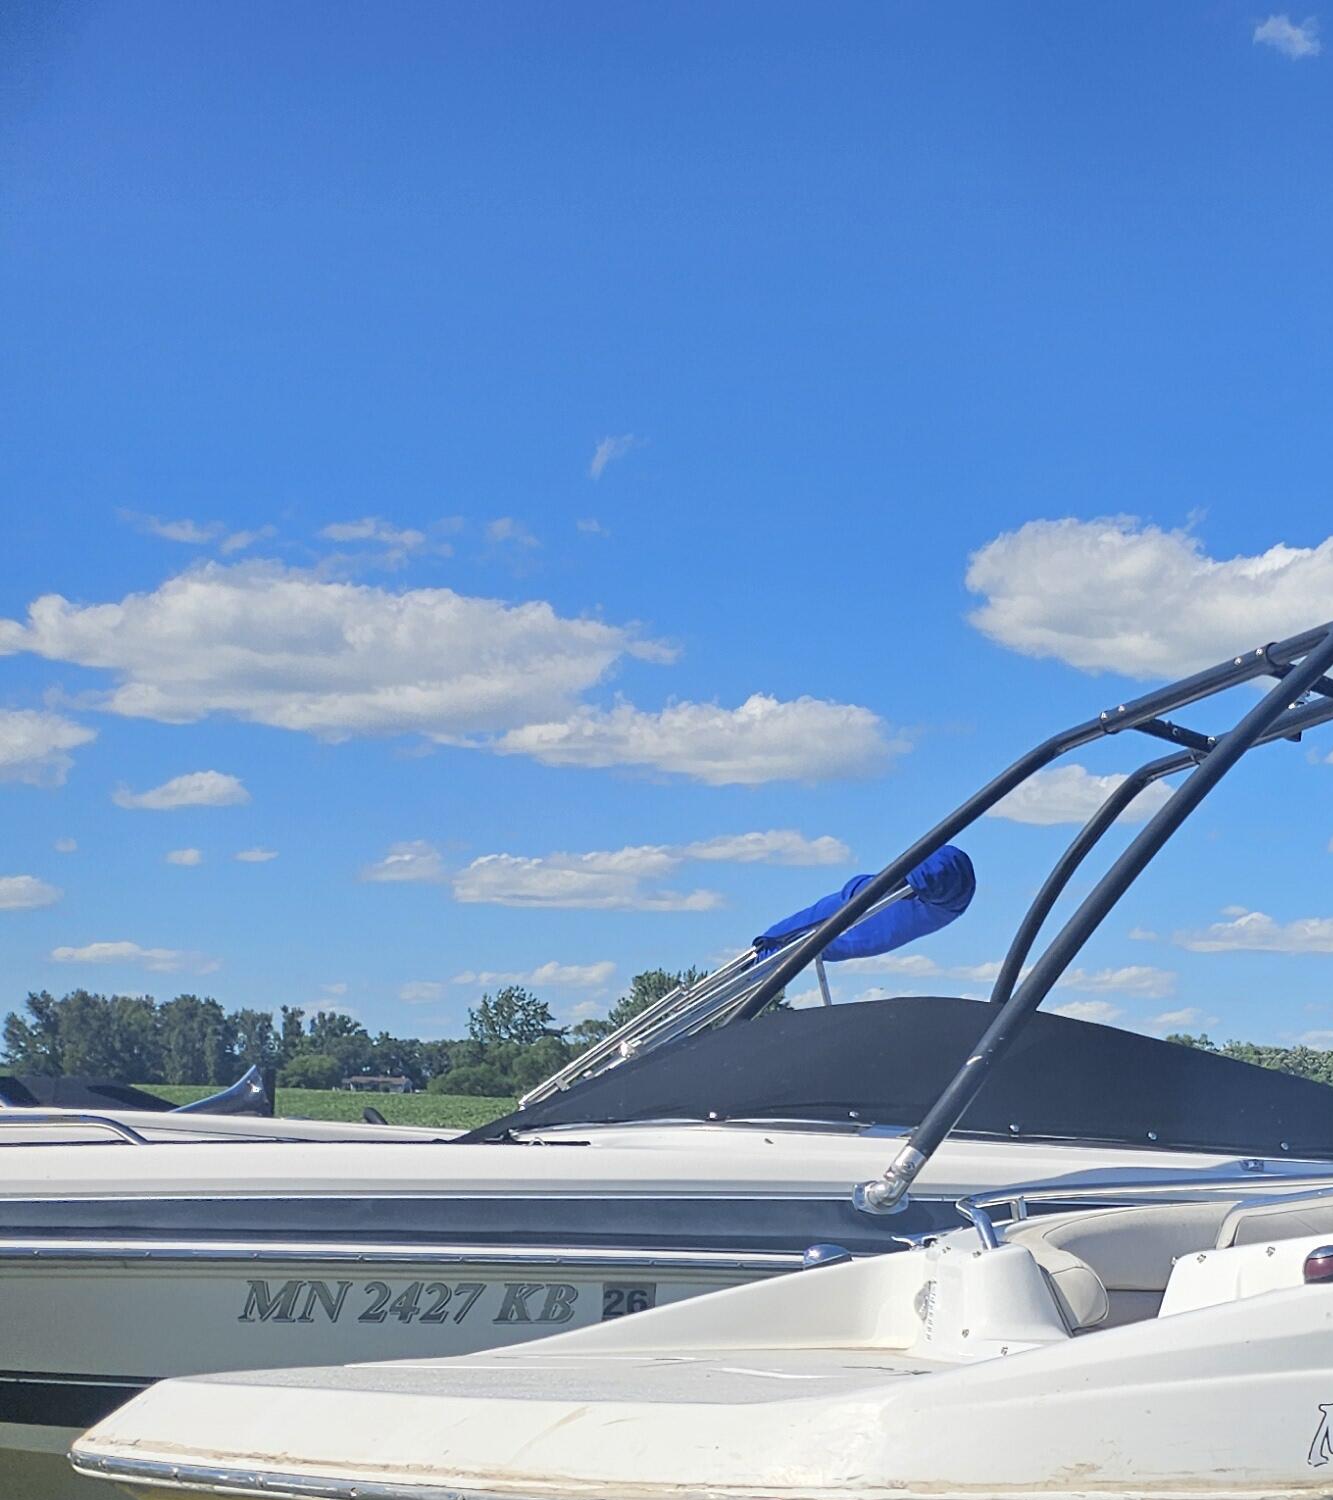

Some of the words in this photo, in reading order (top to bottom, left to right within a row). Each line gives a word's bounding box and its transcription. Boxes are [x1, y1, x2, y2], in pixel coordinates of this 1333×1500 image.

[238, 1280, 353, 1323] MN
[358, 1281, 487, 1323] 2427
[493, 1283, 579, 1324] KB
[603, 1289, 648, 1316] 26
